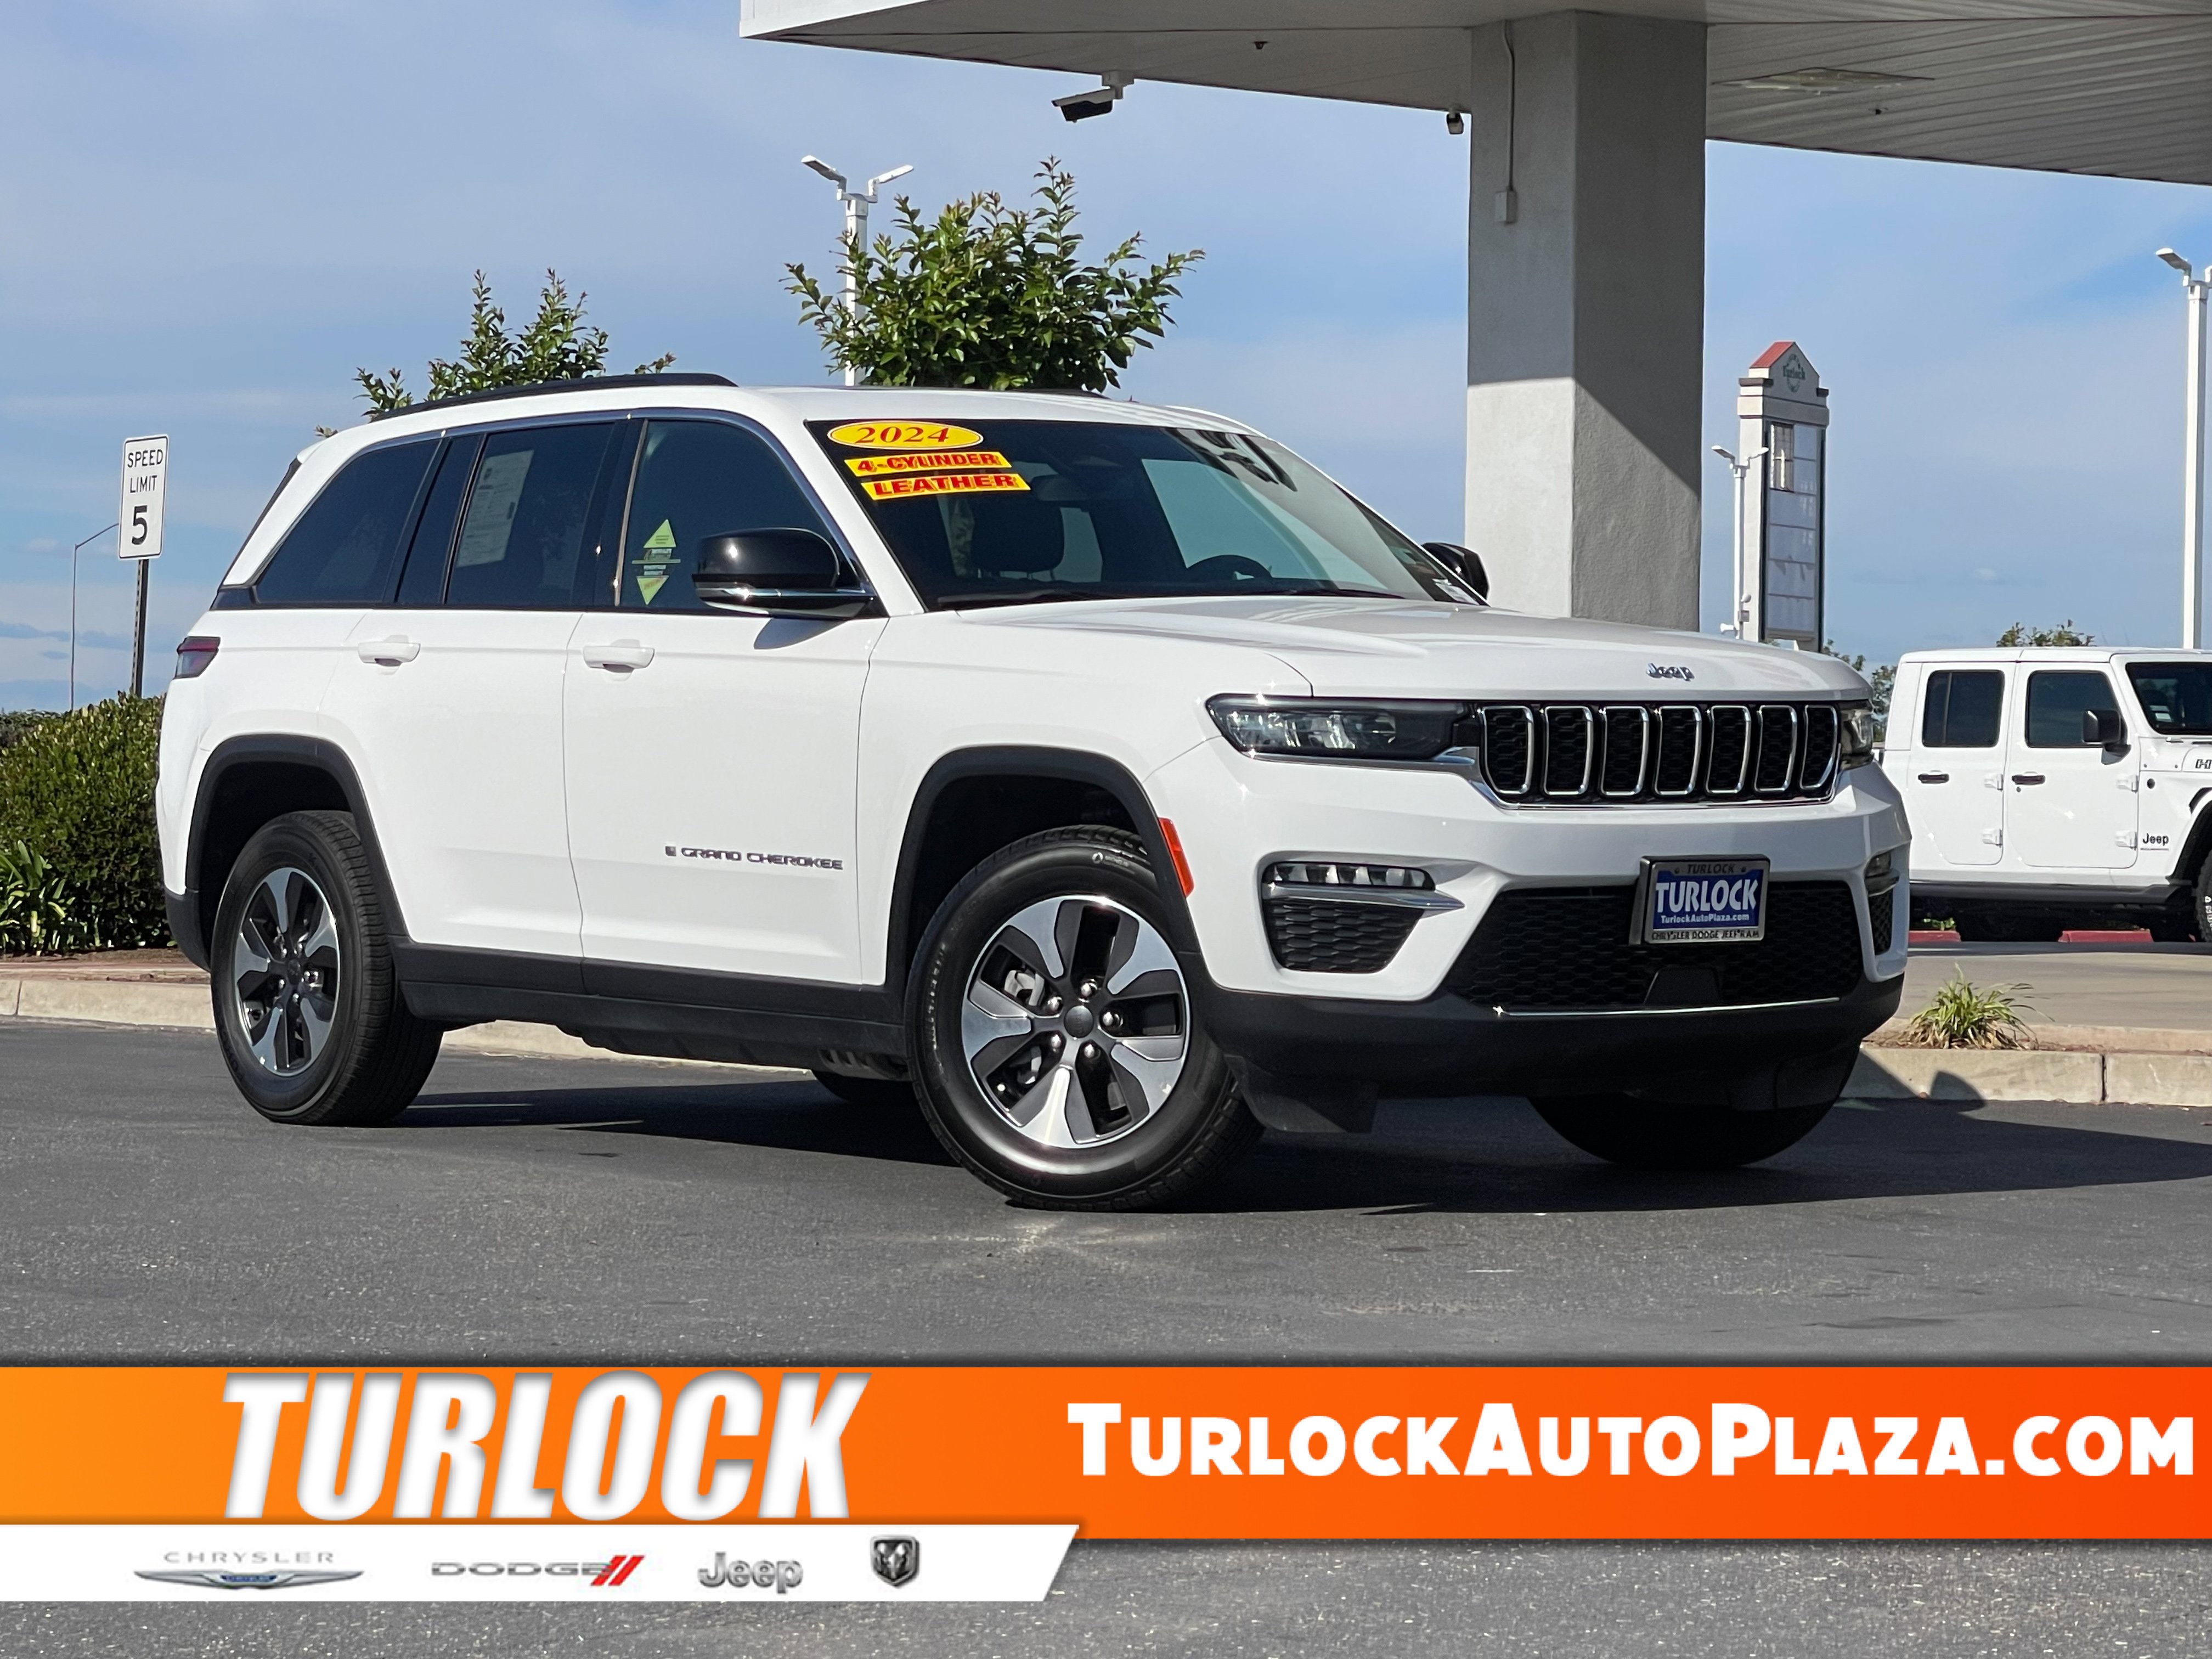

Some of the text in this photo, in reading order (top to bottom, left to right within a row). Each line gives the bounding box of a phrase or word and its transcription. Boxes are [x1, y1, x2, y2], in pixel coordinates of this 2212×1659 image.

[855, 426, 951, 444] 2024
[127, 449, 163, 468] SPEED
[857, 453, 1003, 473] 4-CYLINDER
[129, 475, 157, 493] LIMIT
[873, 475, 1017, 495] LEATHER
[131, 505, 148, 545] 5
[1646, 663, 1695, 681] Jeep
[2142, 833, 2169, 847] Jeep
[681, 847, 843, 870] GRAND CHEROKEE
[1687, 864, 1736, 874] TURLOCK
[1655, 879, 1758, 913] TURLOCK
[1661, 913, 1750, 924] TurlockAutoPlaza.com
[1692, 930, 1719, 939] DODGE
